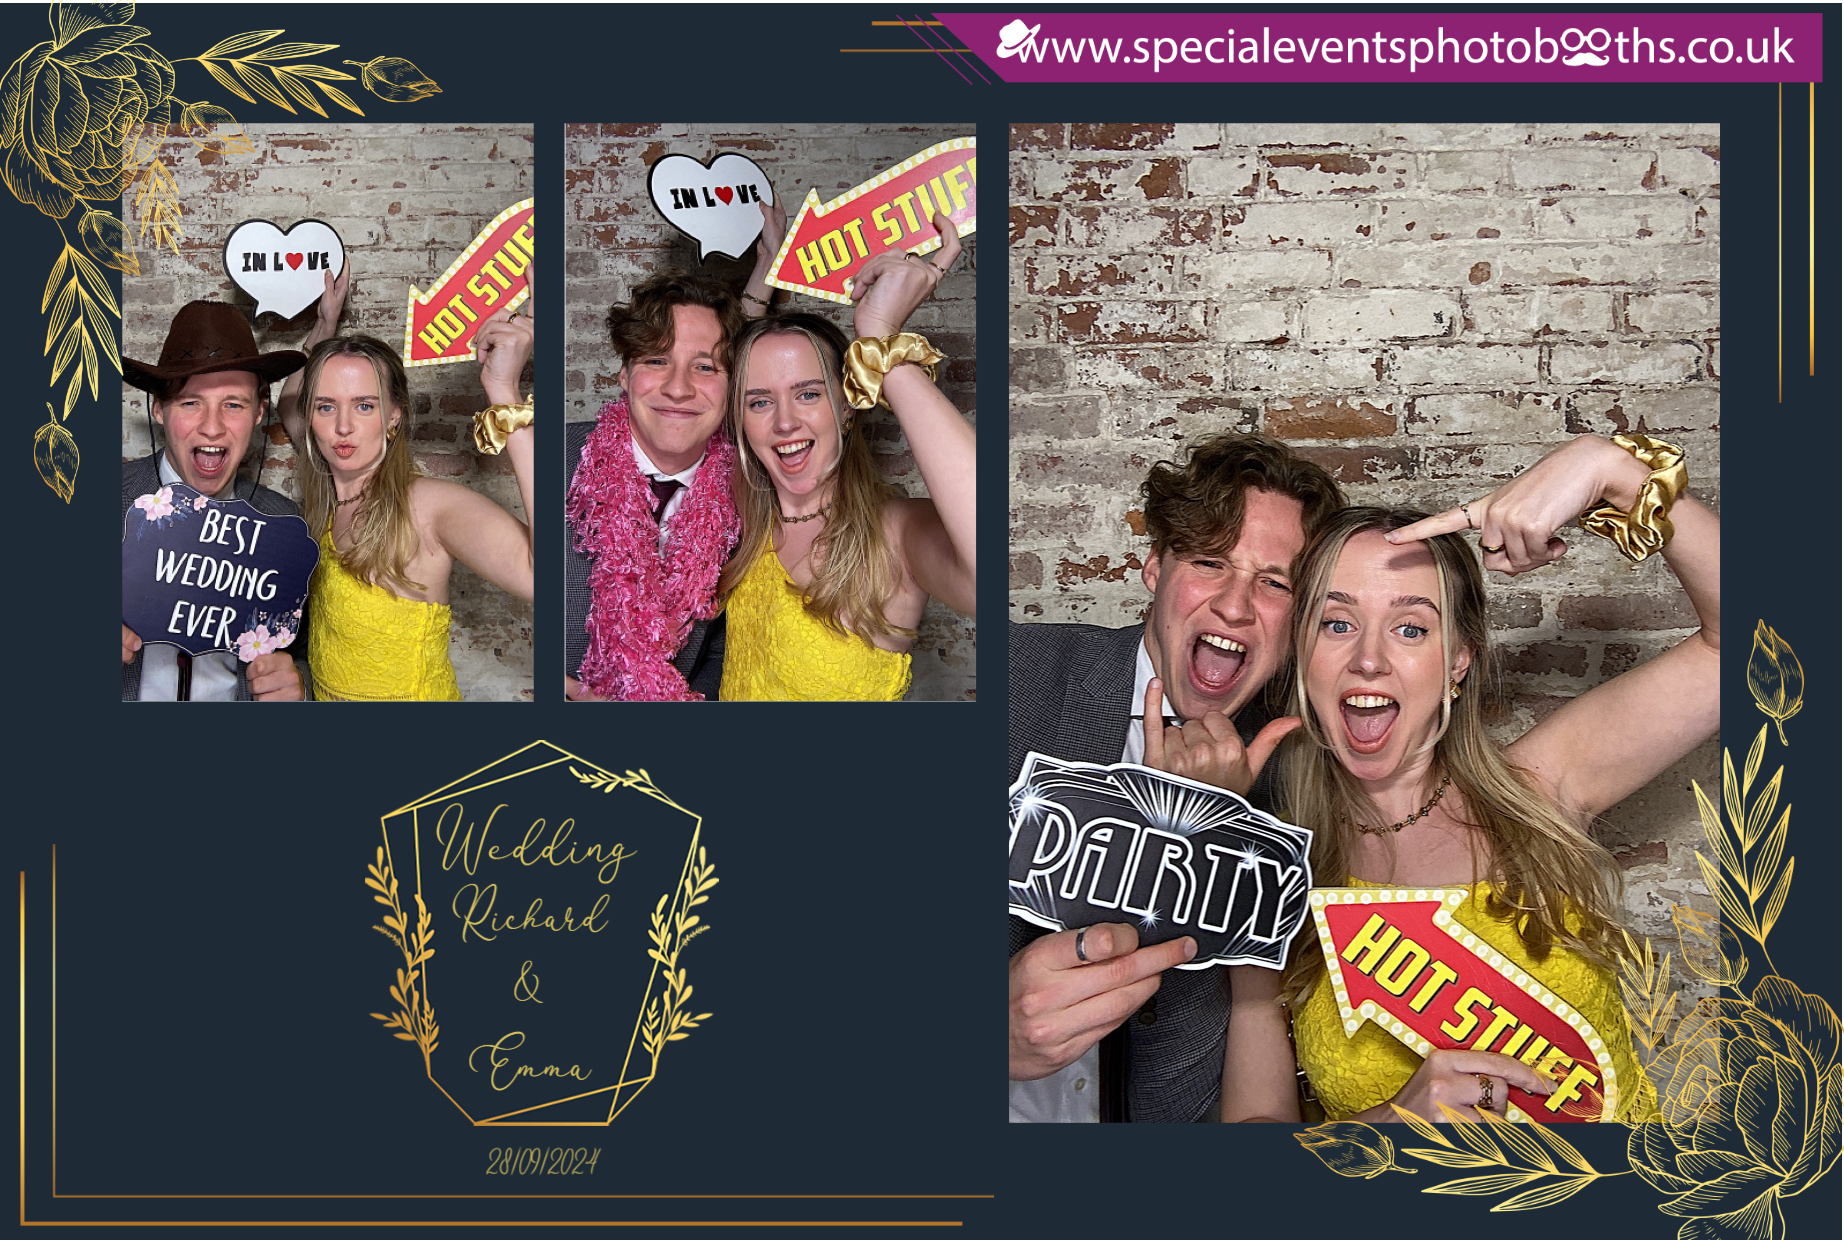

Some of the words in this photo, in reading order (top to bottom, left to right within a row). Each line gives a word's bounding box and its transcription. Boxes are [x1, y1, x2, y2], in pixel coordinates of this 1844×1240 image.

[669, 187, 699, 210] IN
[242, 252, 266, 272] IN
[795, 217, 871, 285] HOT
[418, 292, 479, 356] HOT
[466, 214, 534, 306] STUF
[199, 508, 267, 555] BEST
[155, 548, 279, 601] WEDDING
[167, 600, 237, 648] EVER
[1009, 795, 1303, 944] PARTY
[1340, 912, 1459, 1014] HOT
